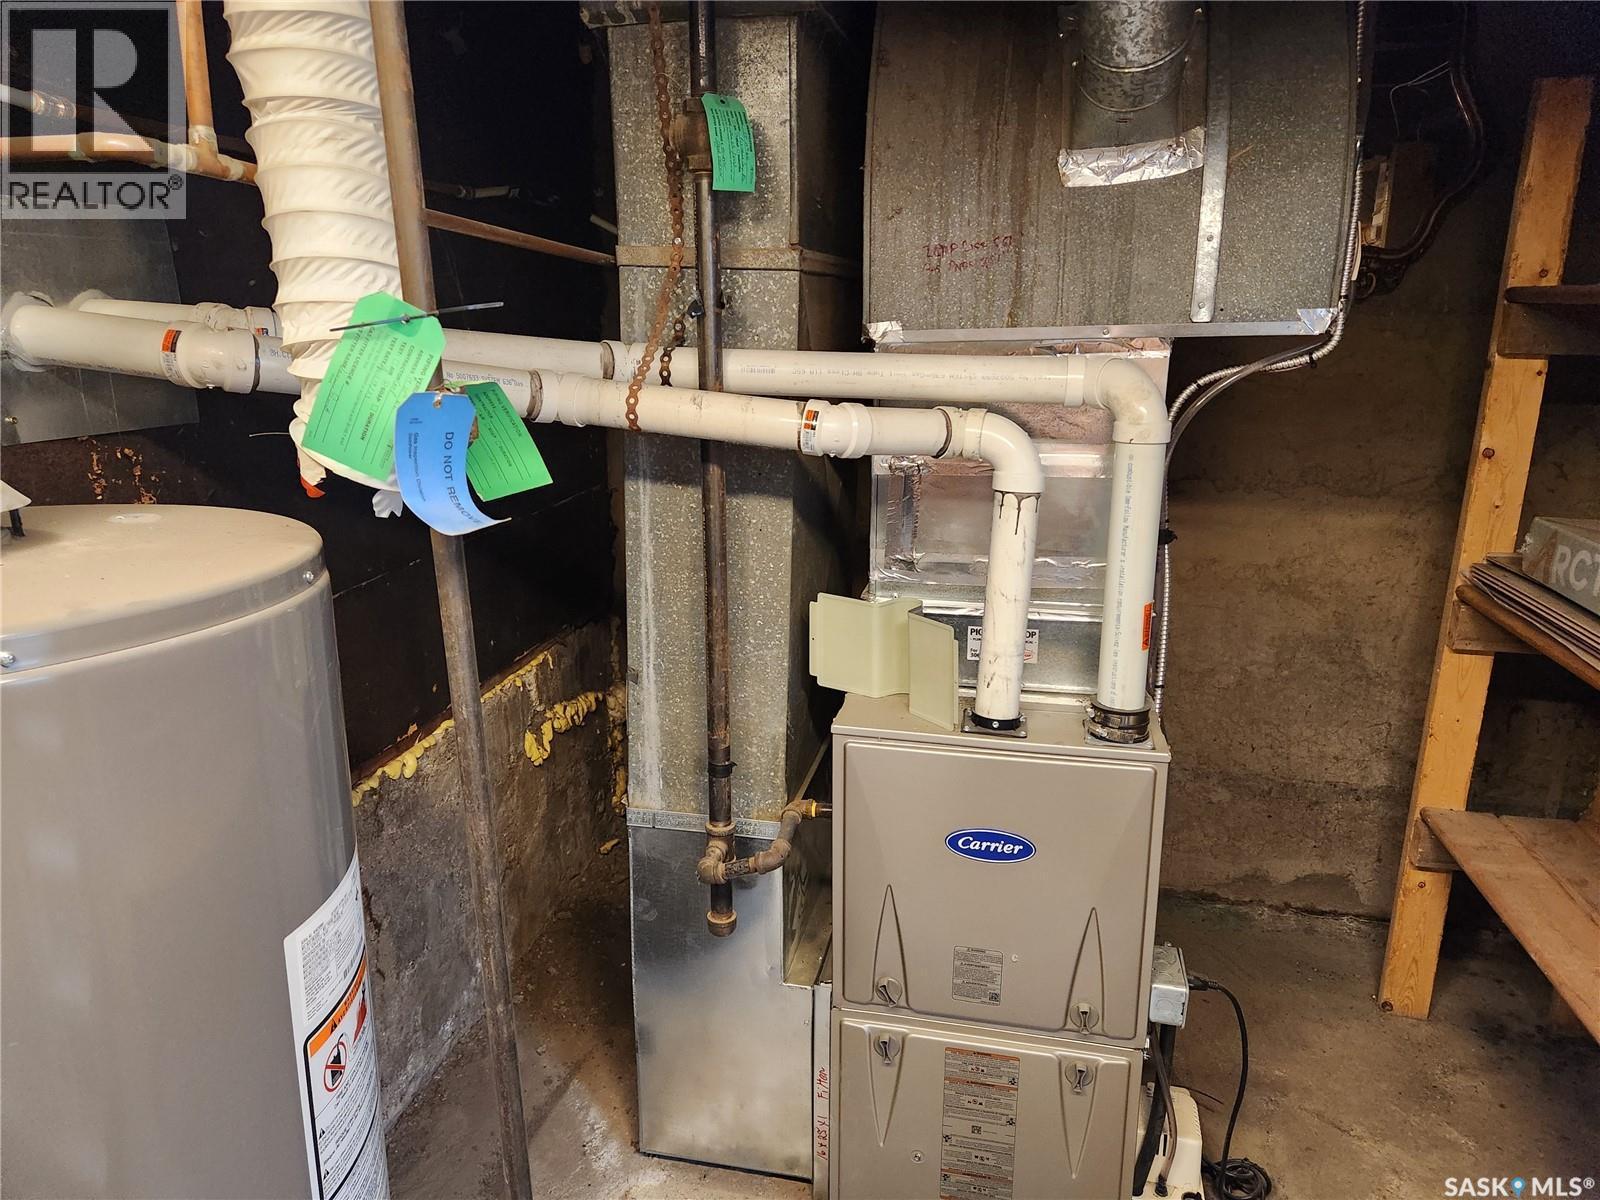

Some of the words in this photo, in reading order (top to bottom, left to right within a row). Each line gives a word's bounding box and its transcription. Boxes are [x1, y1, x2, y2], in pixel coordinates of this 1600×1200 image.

[444, 432, 454, 450] DO
[443, 455, 453, 480] NOT
[958, 836, 1024, 854] Carrier
